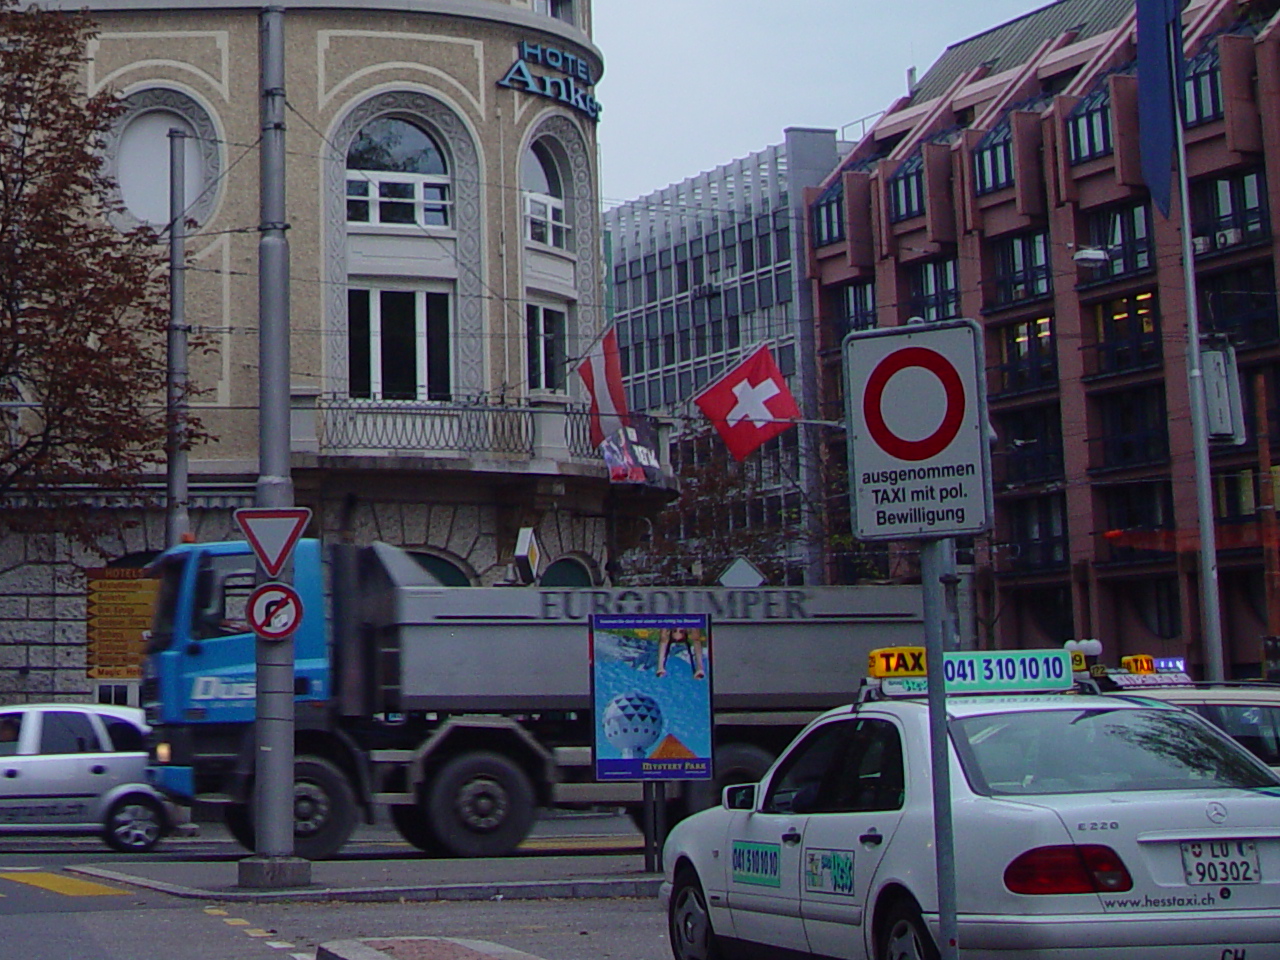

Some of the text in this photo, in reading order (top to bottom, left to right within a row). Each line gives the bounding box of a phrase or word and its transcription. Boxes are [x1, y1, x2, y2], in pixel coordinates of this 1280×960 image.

[522, 41, 594, 85] HOTEL
[497, 59, 602, 122] Anker
[862, 463, 975, 486] ausgenommen
[871, 482, 968, 504] TAXI mit pol.
[876, 507, 965, 526] Bewilligung
[105, 568, 144, 578] HOTELS
[880, 651, 925, 673] TAX
[944, 656, 1063, 682] 041 310 10 10
[1132, 658, 1154, 672] TAXI
[97, 668, 121, 677] Magic
[642, 761, 706, 770] MYSTERY PARK
[1078, 821, 1119, 831] E 220
[1210, 842, 1229, 858] LU
[732, 848, 745, 871] 041
[747, 849, 759, 873] 310
[1195, 860, 1252, 882] 90302
[1104, 893, 1215, 908] www.hesstaxi.ch
